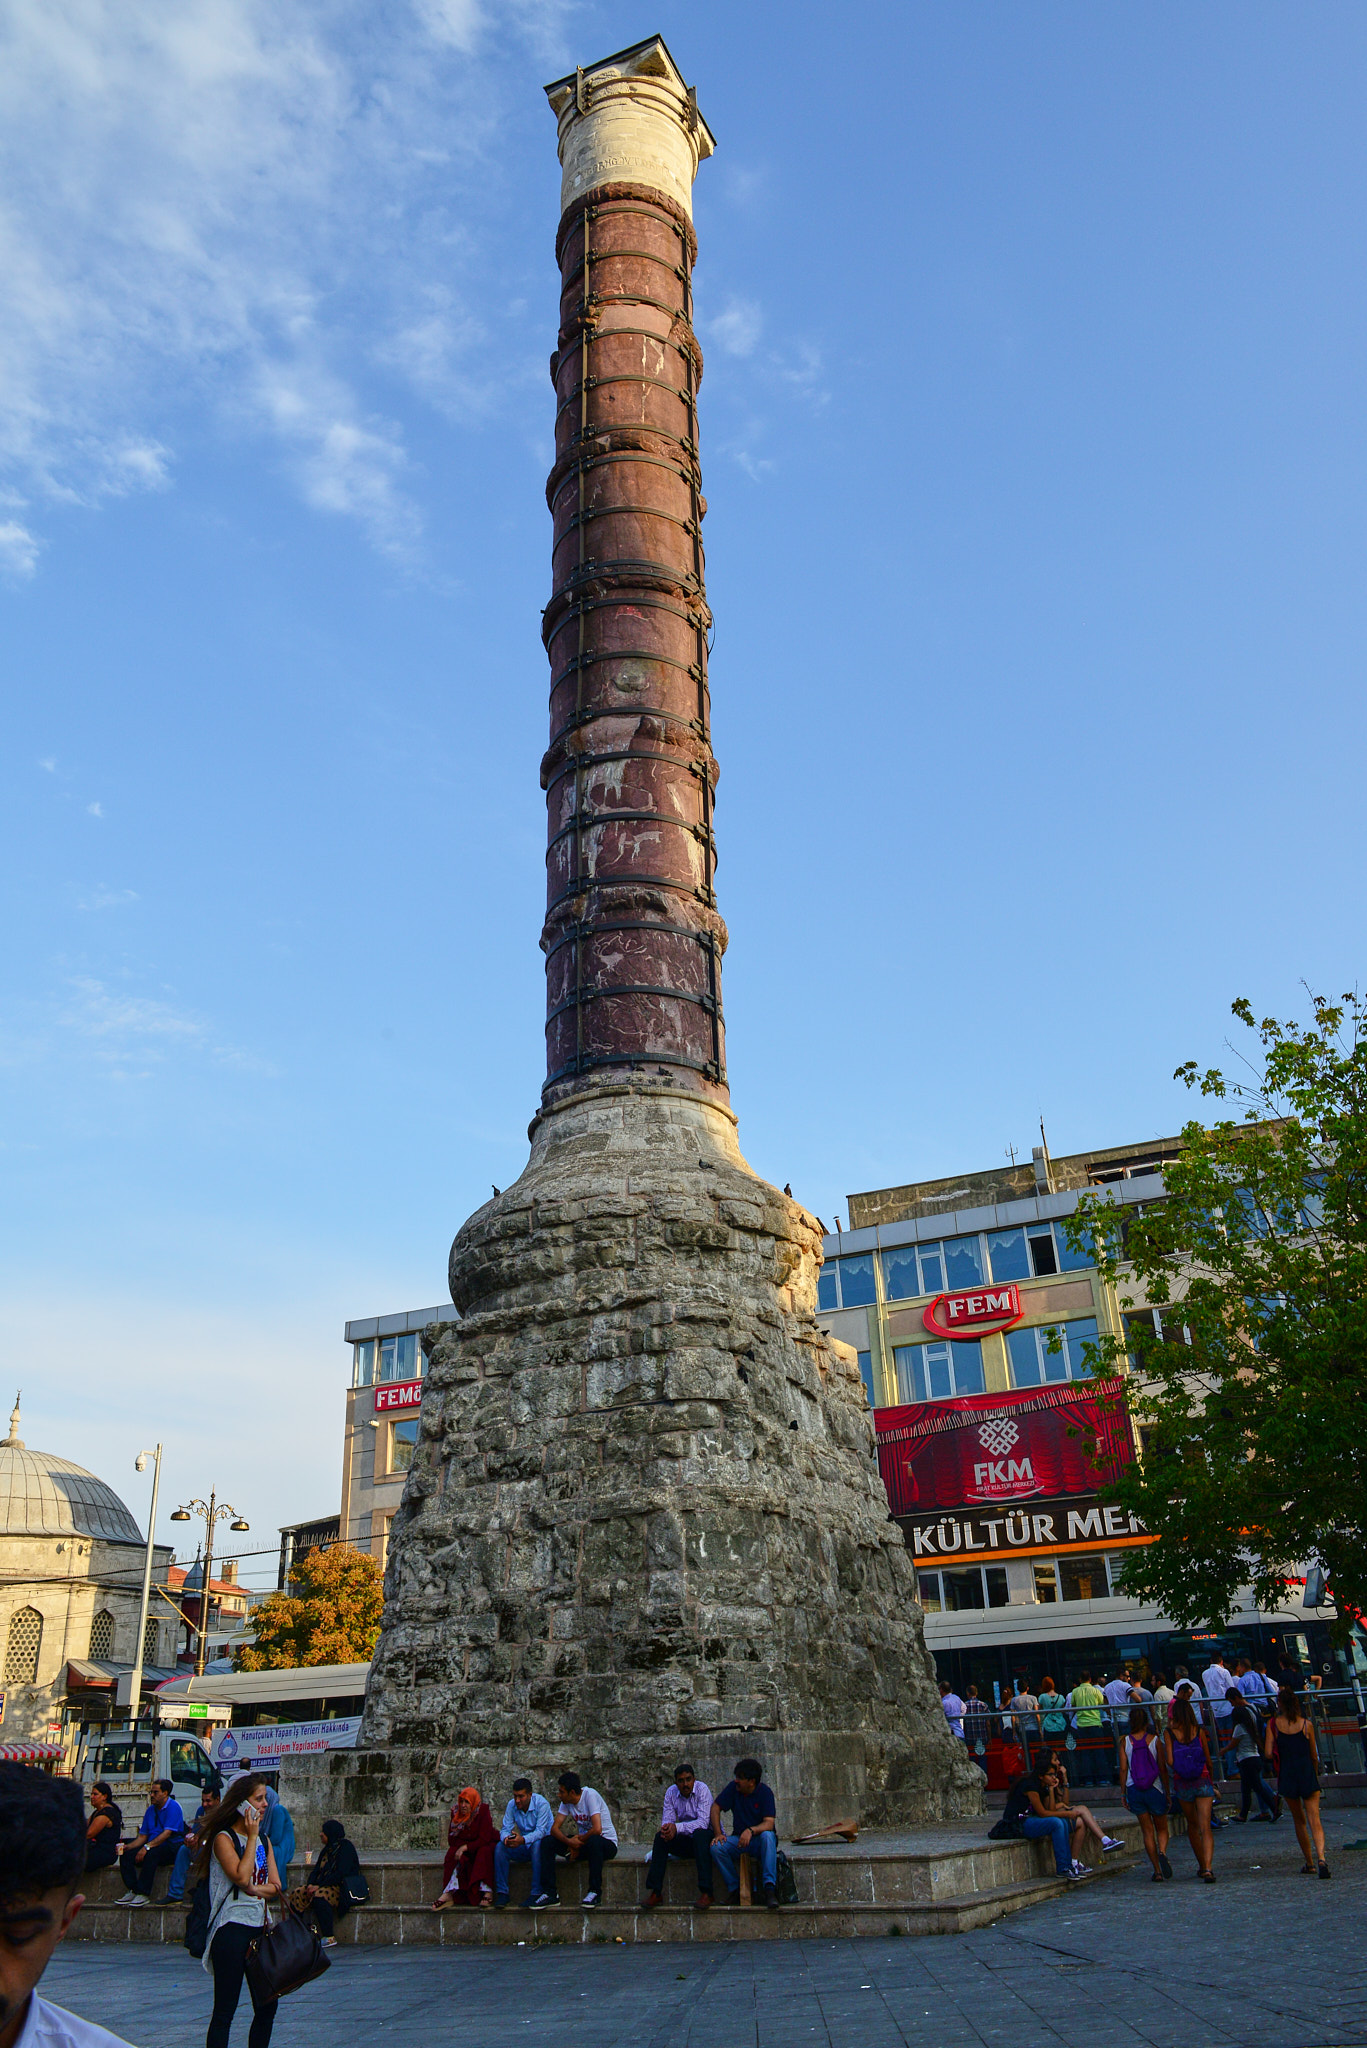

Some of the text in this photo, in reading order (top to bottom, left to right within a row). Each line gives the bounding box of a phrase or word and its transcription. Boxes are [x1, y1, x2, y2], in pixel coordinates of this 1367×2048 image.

[948, 1291, 1011, 1318] FEM
[974, 1457, 1034, 1485] FKM
[913, 1510, 1058, 1555] KÜLTÜR
[241, 1722, 349, 1742] Hanutçuluk Yapan İş Yerleri Hakkında
[257, 1744, 273, 1755] Yasal
[274, 1740, 290, 1755] İşlem
